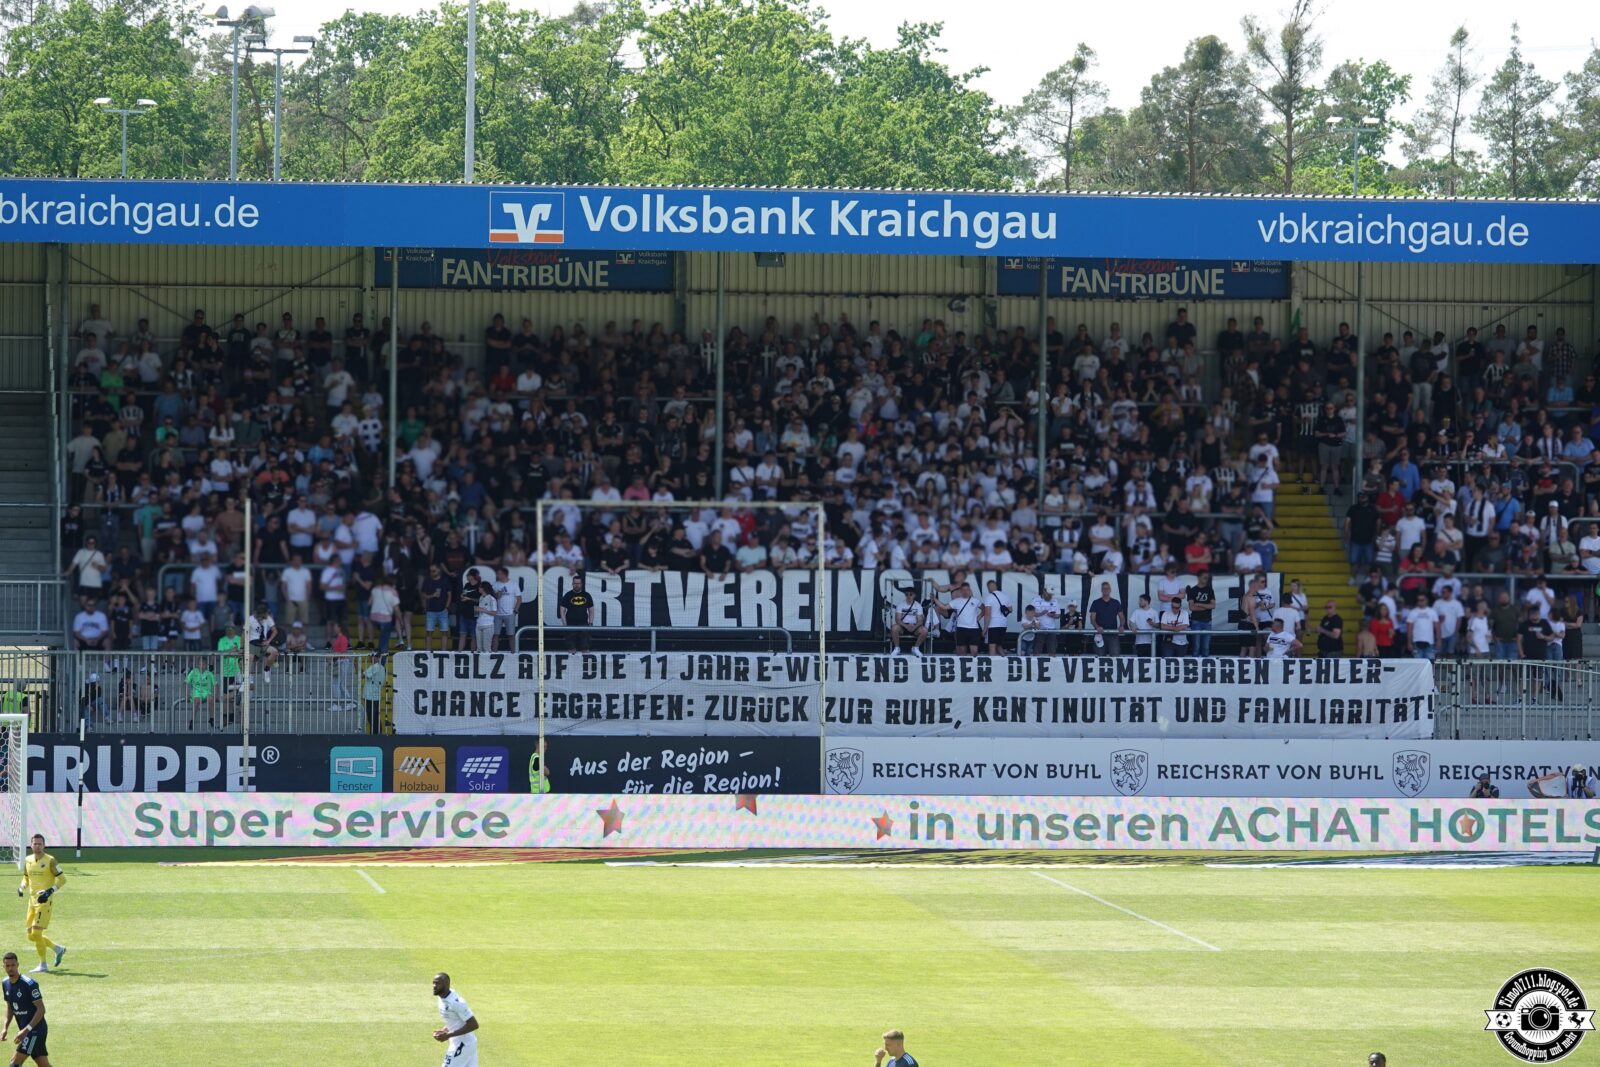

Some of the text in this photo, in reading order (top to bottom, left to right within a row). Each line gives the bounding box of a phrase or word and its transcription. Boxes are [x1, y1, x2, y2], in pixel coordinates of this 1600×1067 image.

[0, 193, 259, 235] bkraichgau.de
[579, 194, 1058, 249] Volksbank Kraichgau
[1257, 212, 1529, 254] vbkraichgau.de
[442, 256, 609, 288] FAN-TRIBÜNE
[1061, 265, 1225, 296] FAN-TRIBÜNE
[413, 653, 506, 680] STOLZ
[518, 654, 569, 680] AUF
[582, 654, 627, 680] DIE
[640, 655, 668, 680] 11
[921, 656, 992, 683] ÜBER
[1007, 657, 1052, 682] DIE
[1062, 657, 1270, 684] VERMEIDBAREN
[1283, 658, 1396, 684] FEHLER-
[413, 688, 1435, 729] CHANCE ERGREIFEN: ZURÜCK ZUR RUHE, KONTINUITÄT UND FAMILIARITÄT!
[569, 757, 608, 776] Aus
[617, 752, 652, 772] der
[661, 747, 729, 774] Region
[872, 763, 1102, 779] REICHSRAT VON BUHL
[1157, 764, 1384, 780] REICHSRAT VON BUHL
[1558, 765, 1600, 781] VN
[337, 781, 374, 791] Fenster
[400, 781, 439, 792] Holzbau
[468, 781, 496, 791] Solar
[621, 767, 781, 794] für die Region!
[134, 799, 511, 846] Super Service
[909, 800, 1600, 844] in unseren ACHAT HOTELS
